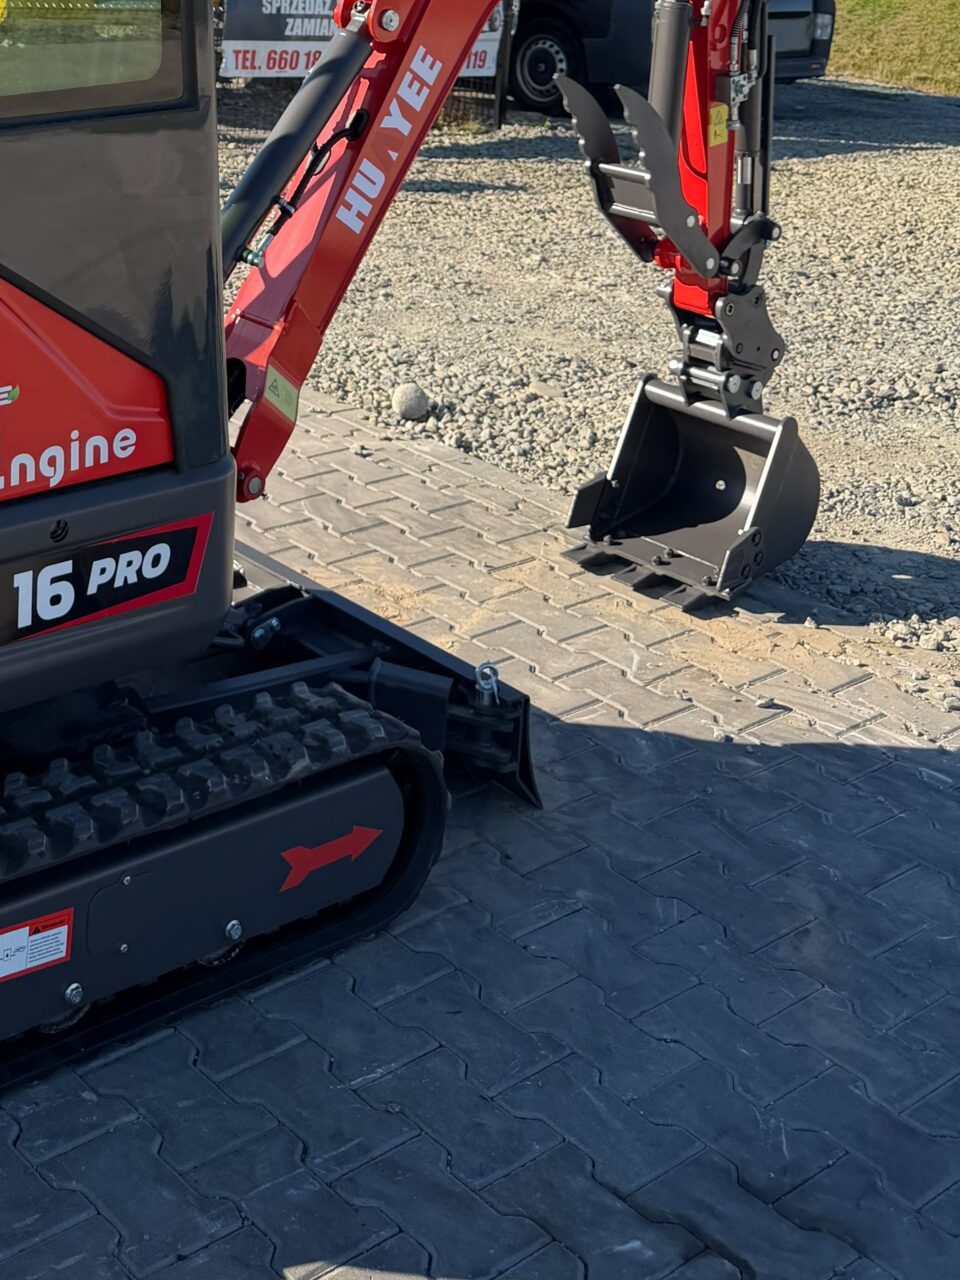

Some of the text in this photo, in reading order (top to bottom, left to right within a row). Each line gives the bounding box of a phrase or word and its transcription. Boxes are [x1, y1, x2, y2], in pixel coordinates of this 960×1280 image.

[233, 49, 261, 70] TEL.
[266, 49, 300, 70] 660
[304, 49, 322, 70] 18
[13, 542, 171, 629] 16 PRO
